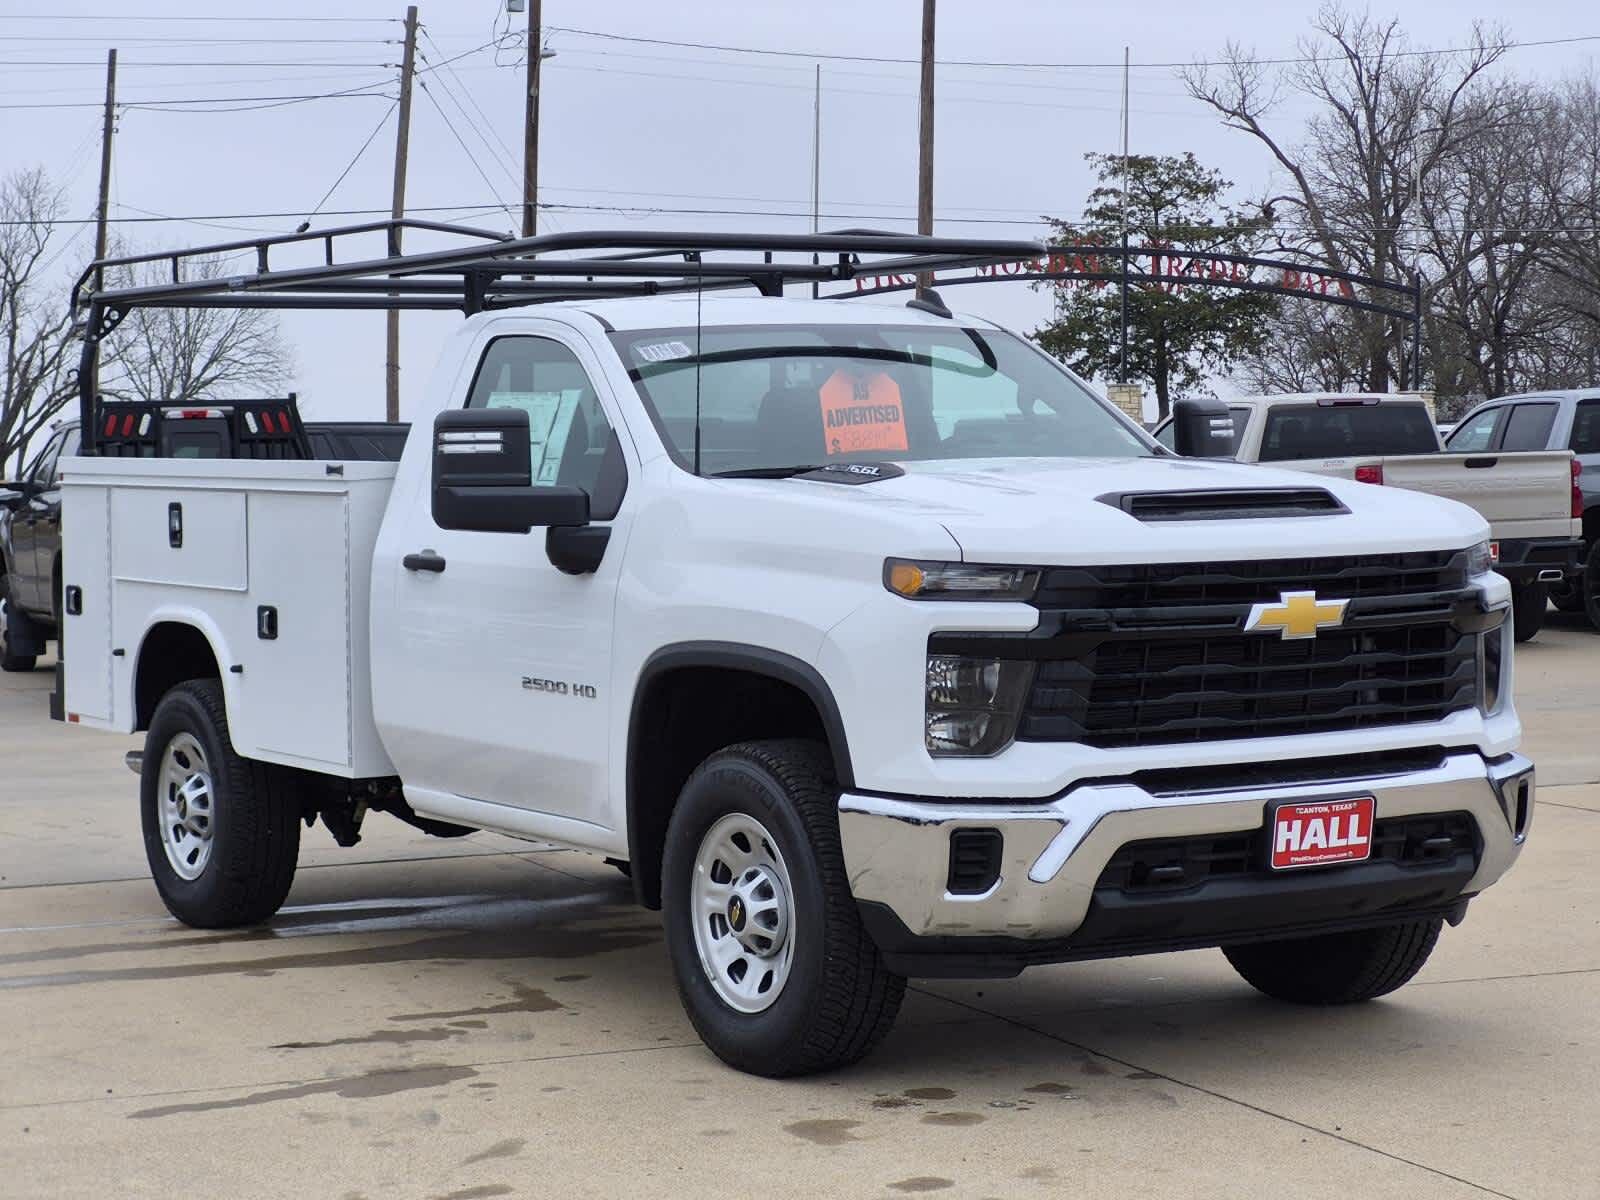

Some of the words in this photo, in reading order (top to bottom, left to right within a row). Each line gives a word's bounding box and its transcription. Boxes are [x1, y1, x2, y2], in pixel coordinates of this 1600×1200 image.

[1148, 254, 1248, 284] TRADE
[827, 405, 899, 428] ADVERTISED
[521, 676, 568, 695] 2500
[573, 682, 596, 698] HD
[1331, 803, 1353, 812] TEXAS
[1276, 814, 1368, 853] HALL
